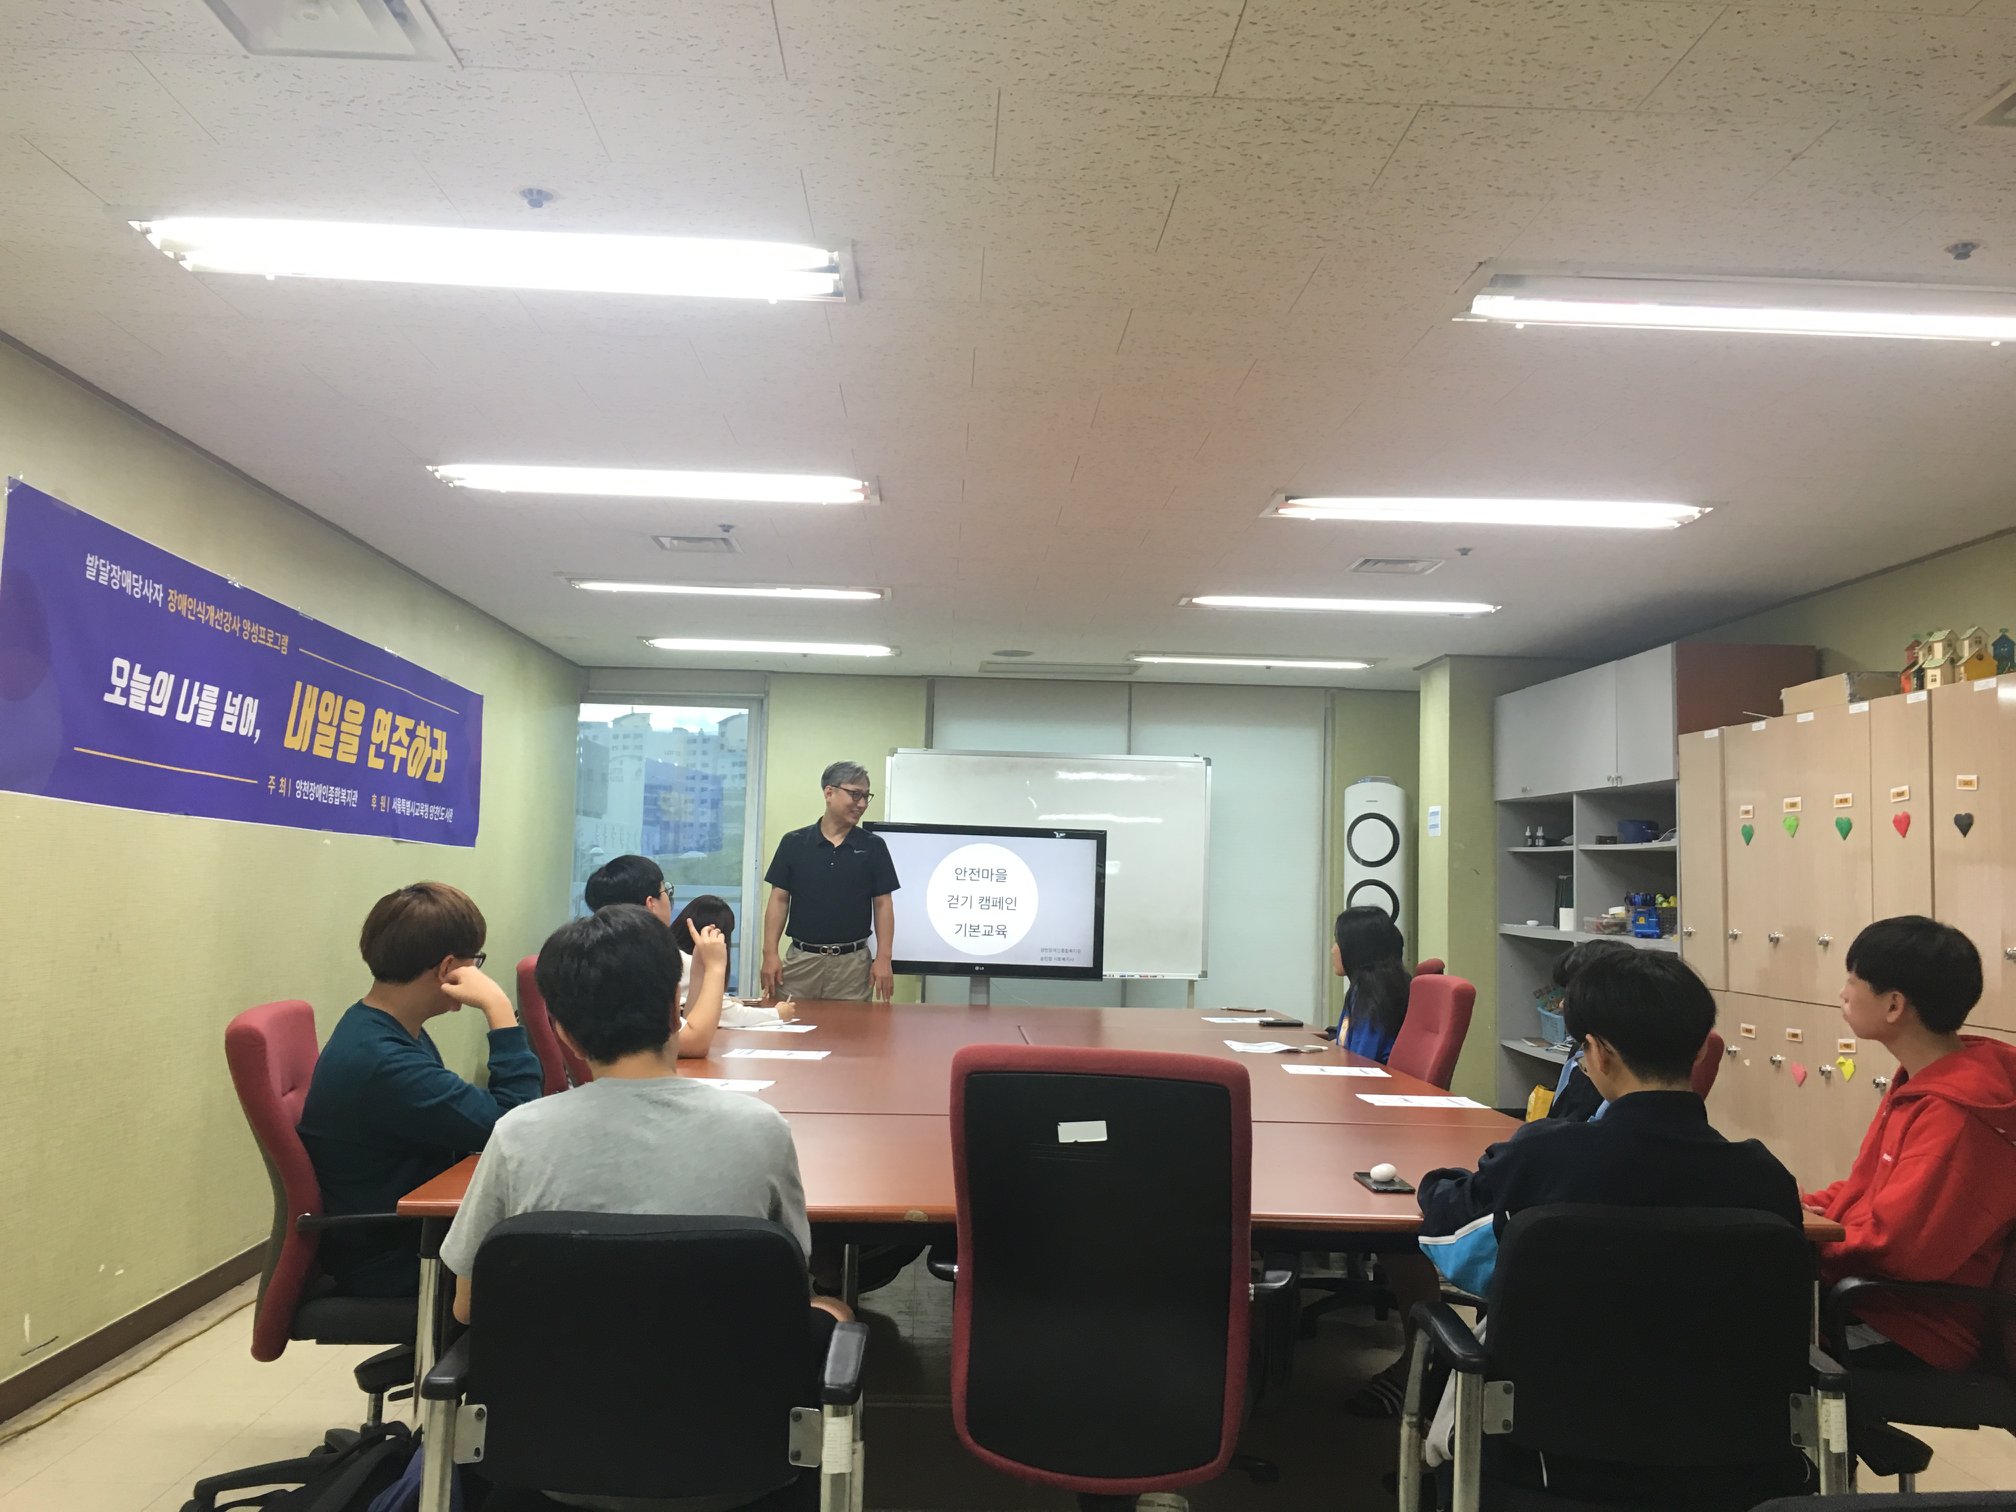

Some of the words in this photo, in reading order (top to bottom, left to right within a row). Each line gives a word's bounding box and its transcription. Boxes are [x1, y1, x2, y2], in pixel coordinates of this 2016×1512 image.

[85, 553, 163, 607] 발달장애당사자
[167, 589, 240, 637] 장애인식개선강사
[242, 619, 289, 655] 양성프로그램
[103, 656, 175, 717] 오늘의
[175, 678, 220, 728] 나를
[220, 690, 261, 744] 넘어,
[283, 680, 365, 764] 내일을
[367, 707, 448, 784] 연주하라
[295, 779, 359, 808] 양천장애인종합복지관
[954, 866, 1008, 883] 안전마을
[947, 894, 973, 910] 걷기
[978, 895, 1017, 911] 캠페인
[954, 922, 1008, 939] 기본교육
